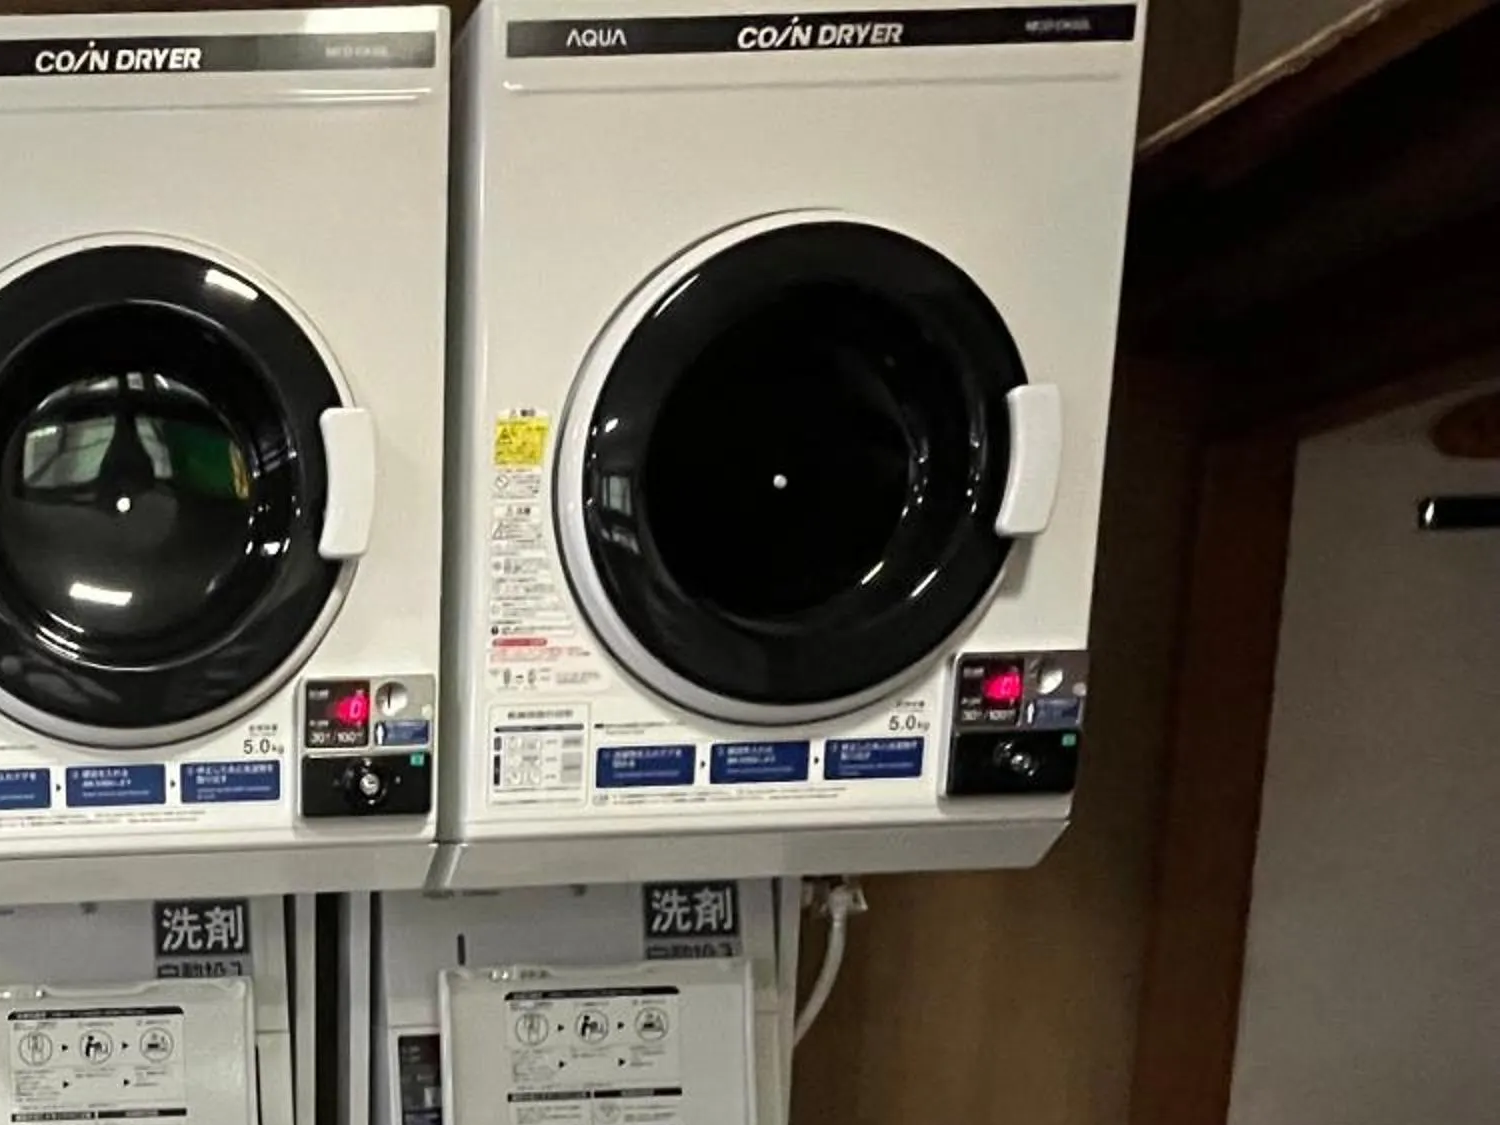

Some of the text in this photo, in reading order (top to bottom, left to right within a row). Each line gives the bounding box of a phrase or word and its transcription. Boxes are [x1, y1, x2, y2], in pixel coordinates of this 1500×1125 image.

[566, 28, 627, 48] AQUA
[737, 17, 904, 49] COIN DRYER
[35, 41, 202, 73] COIN DRYER
[651, 886, 734, 933] 洗剤
[161, 904, 245, 952] 洗剤
